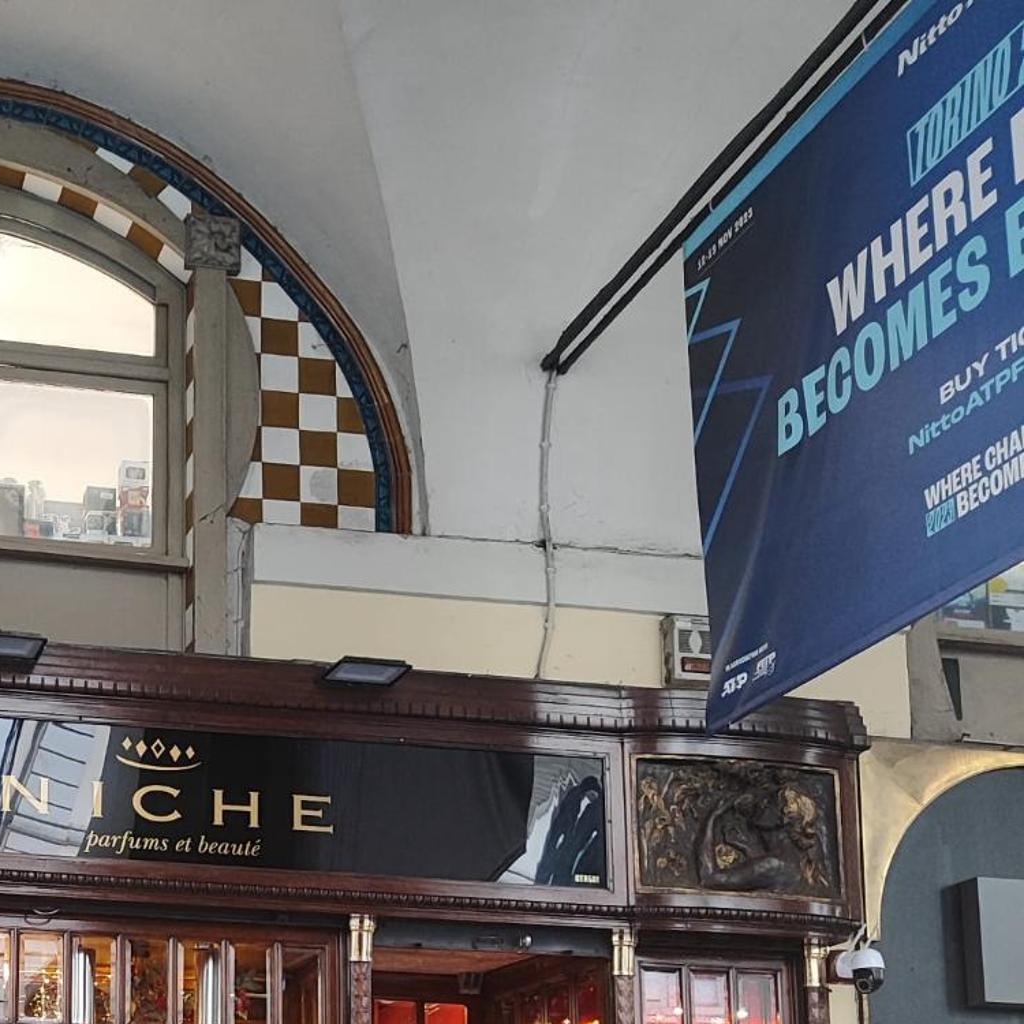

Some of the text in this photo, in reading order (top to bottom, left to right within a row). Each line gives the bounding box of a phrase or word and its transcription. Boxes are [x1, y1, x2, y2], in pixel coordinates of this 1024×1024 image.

[897, 2, 964, 78] Nitto
[914, 36, 1012, 182] TORINO
[826, 137, 997, 336] WHERE
[777, 234, 991, 457] BECOMES
[939, 352, 989, 405] BUY
[924, 454, 981, 510] WHERE
[1, 774, 334, 834] NICHE
[84, 830, 262, 857] parfums et beauté
